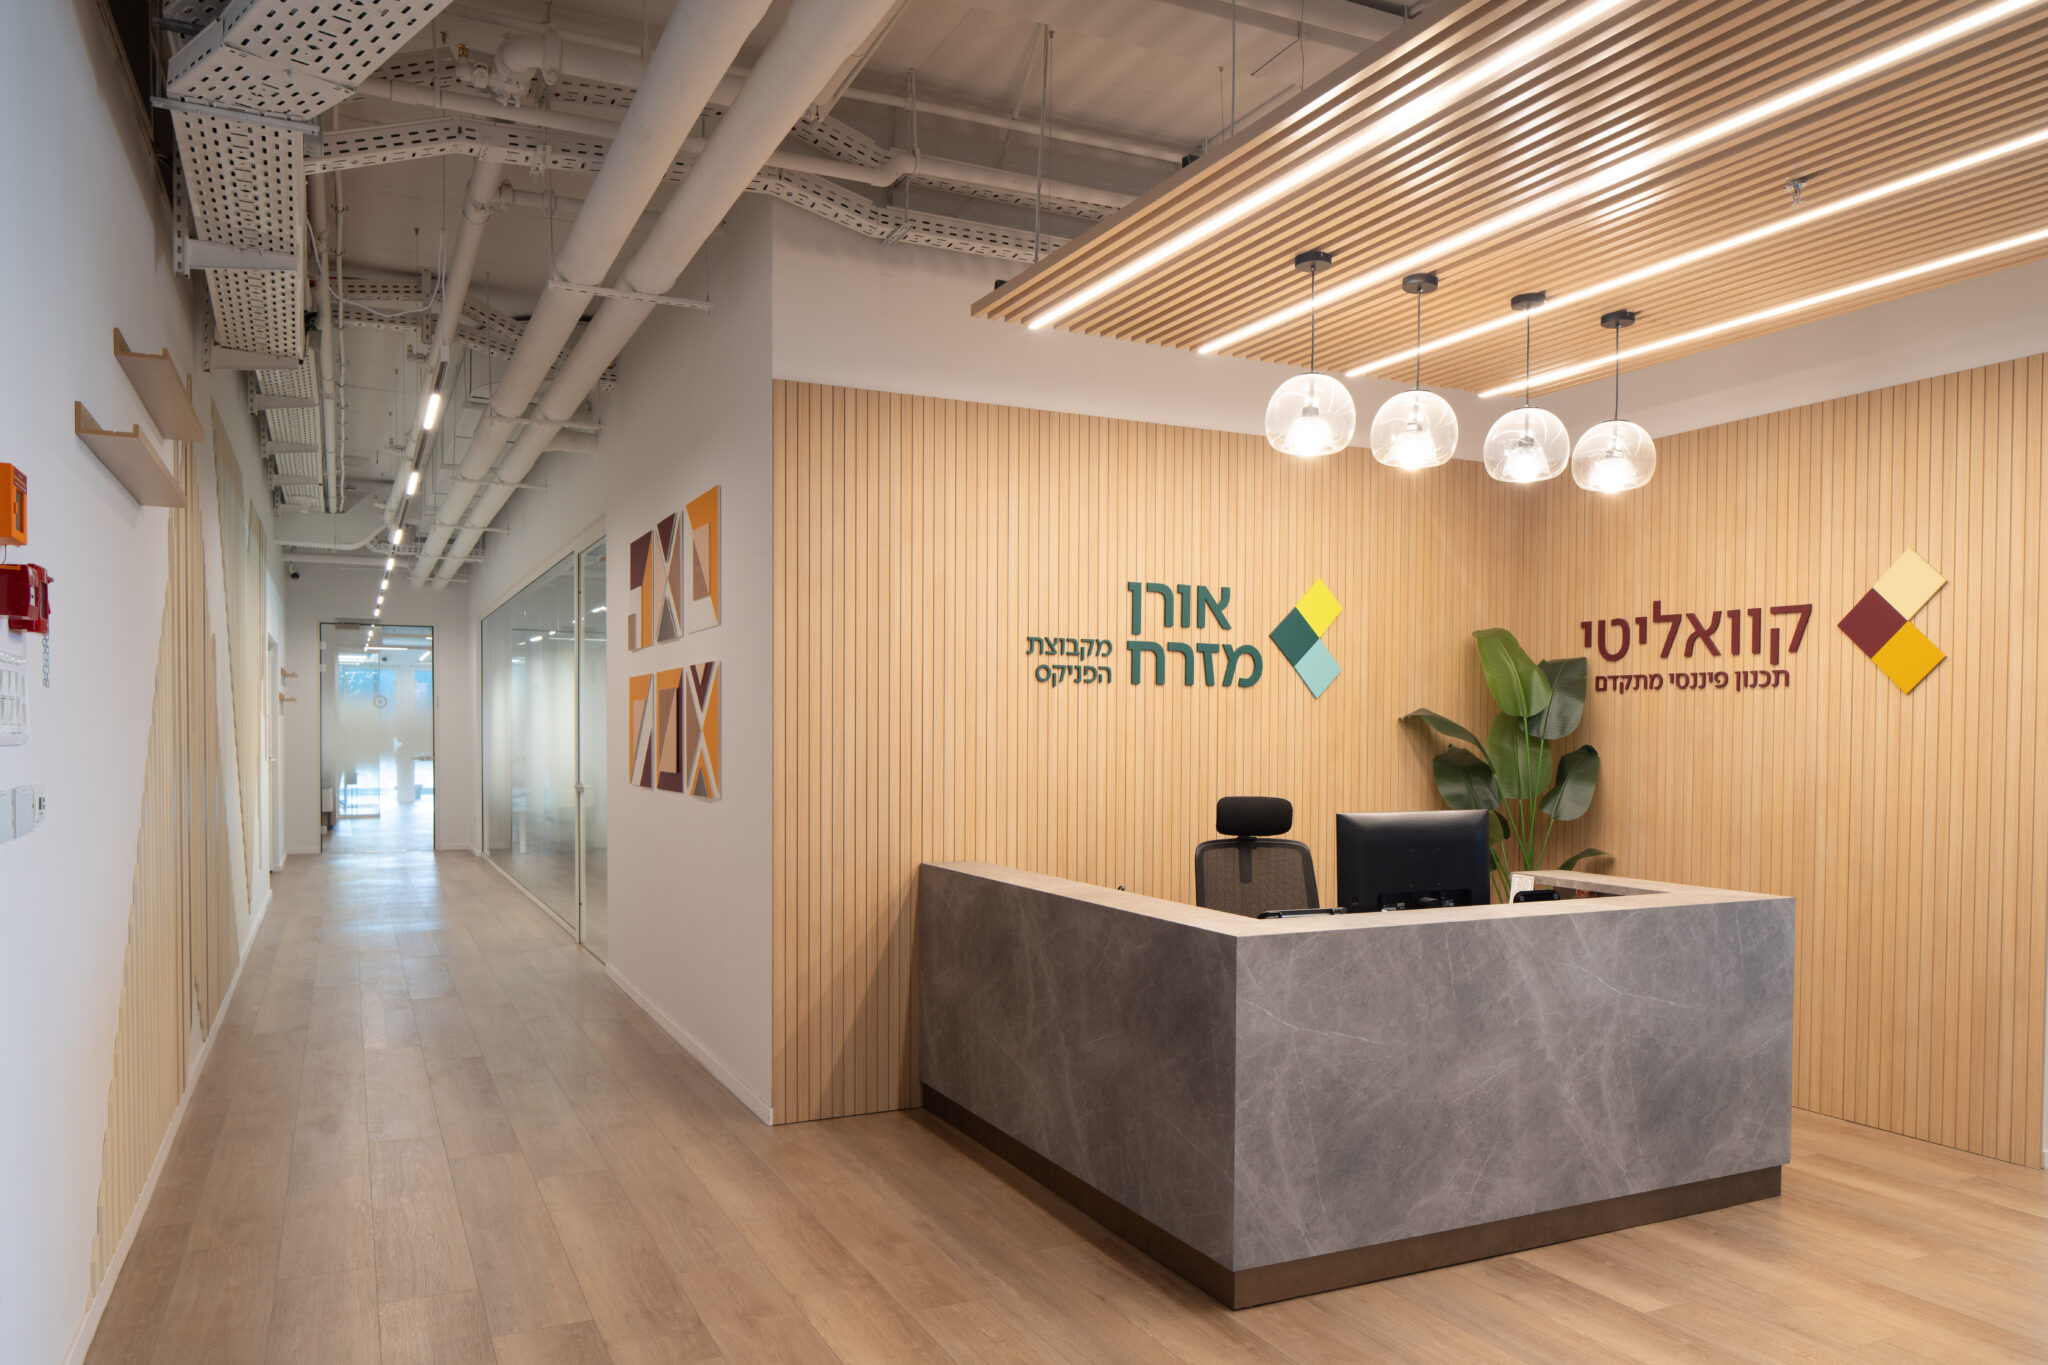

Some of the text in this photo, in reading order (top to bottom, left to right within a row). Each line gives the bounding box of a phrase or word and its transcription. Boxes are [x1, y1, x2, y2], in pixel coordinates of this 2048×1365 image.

[1127, 581, 1232, 635] אורן
[1025, 636, 1113, 661] מקבוצת
[1580, 600, 1813, 666] קוואליטי
[1034, 663, 1112, 688] הפניקס
[1126, 640, 1264, 688] מזרח
[1594, 669, 1790, 695] תכנון פיננסי מתקדם
